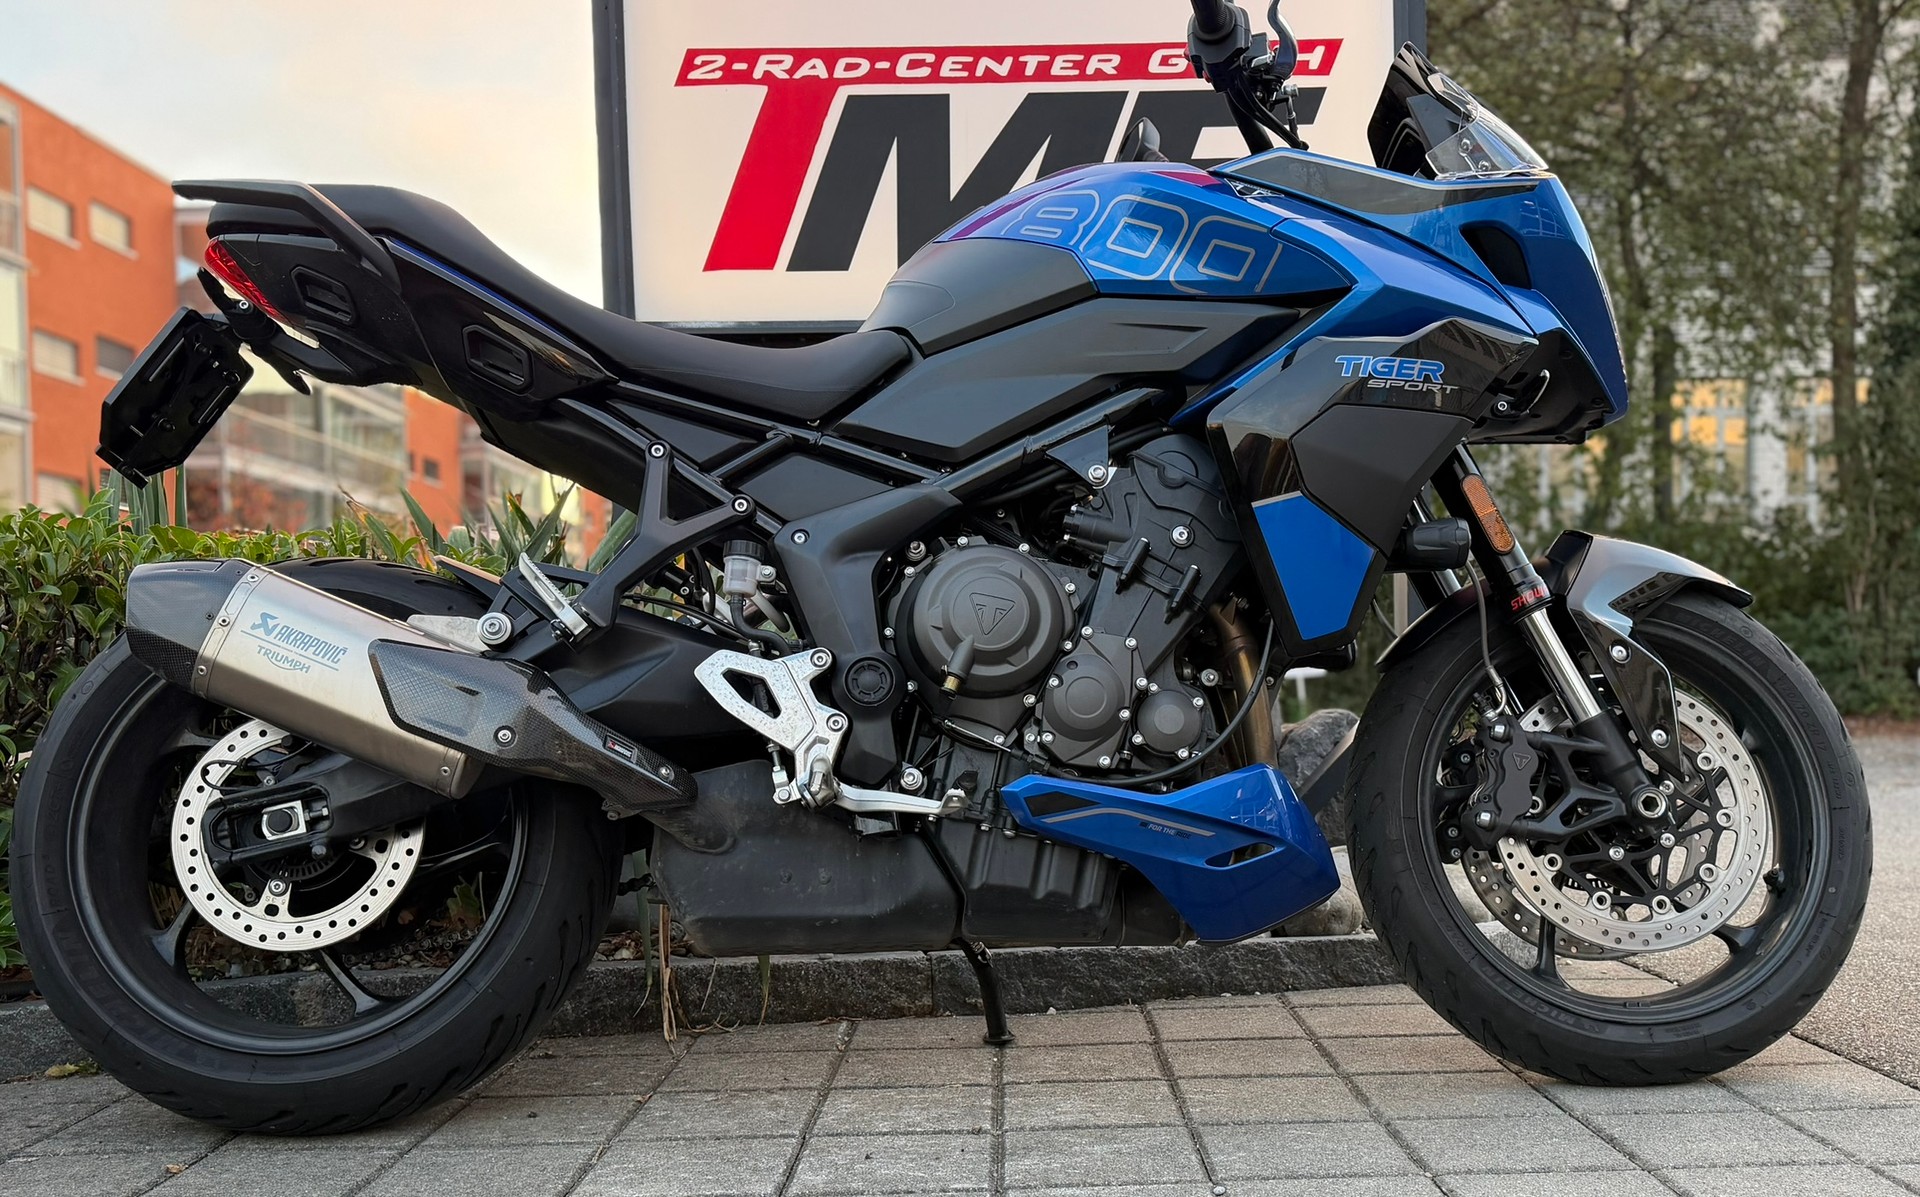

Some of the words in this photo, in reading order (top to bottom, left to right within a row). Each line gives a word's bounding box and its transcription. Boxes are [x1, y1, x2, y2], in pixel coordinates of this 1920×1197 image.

[1147, 45, 1326, 74] GH
[1002, 189, 1283, 294] 800
[1334, 354, 1445, 384] TIGER
[1367, 379, 1459, 394] SPORT
[1510, 585, 1549, 611] SHOW
[257, 644, 312, 674] TRIUMPH
[1147, 823, 1163, 832] FOR
[1163, 827, 1176, 836] THE
[1479, 964, 1577, 1025] MICHELIN
